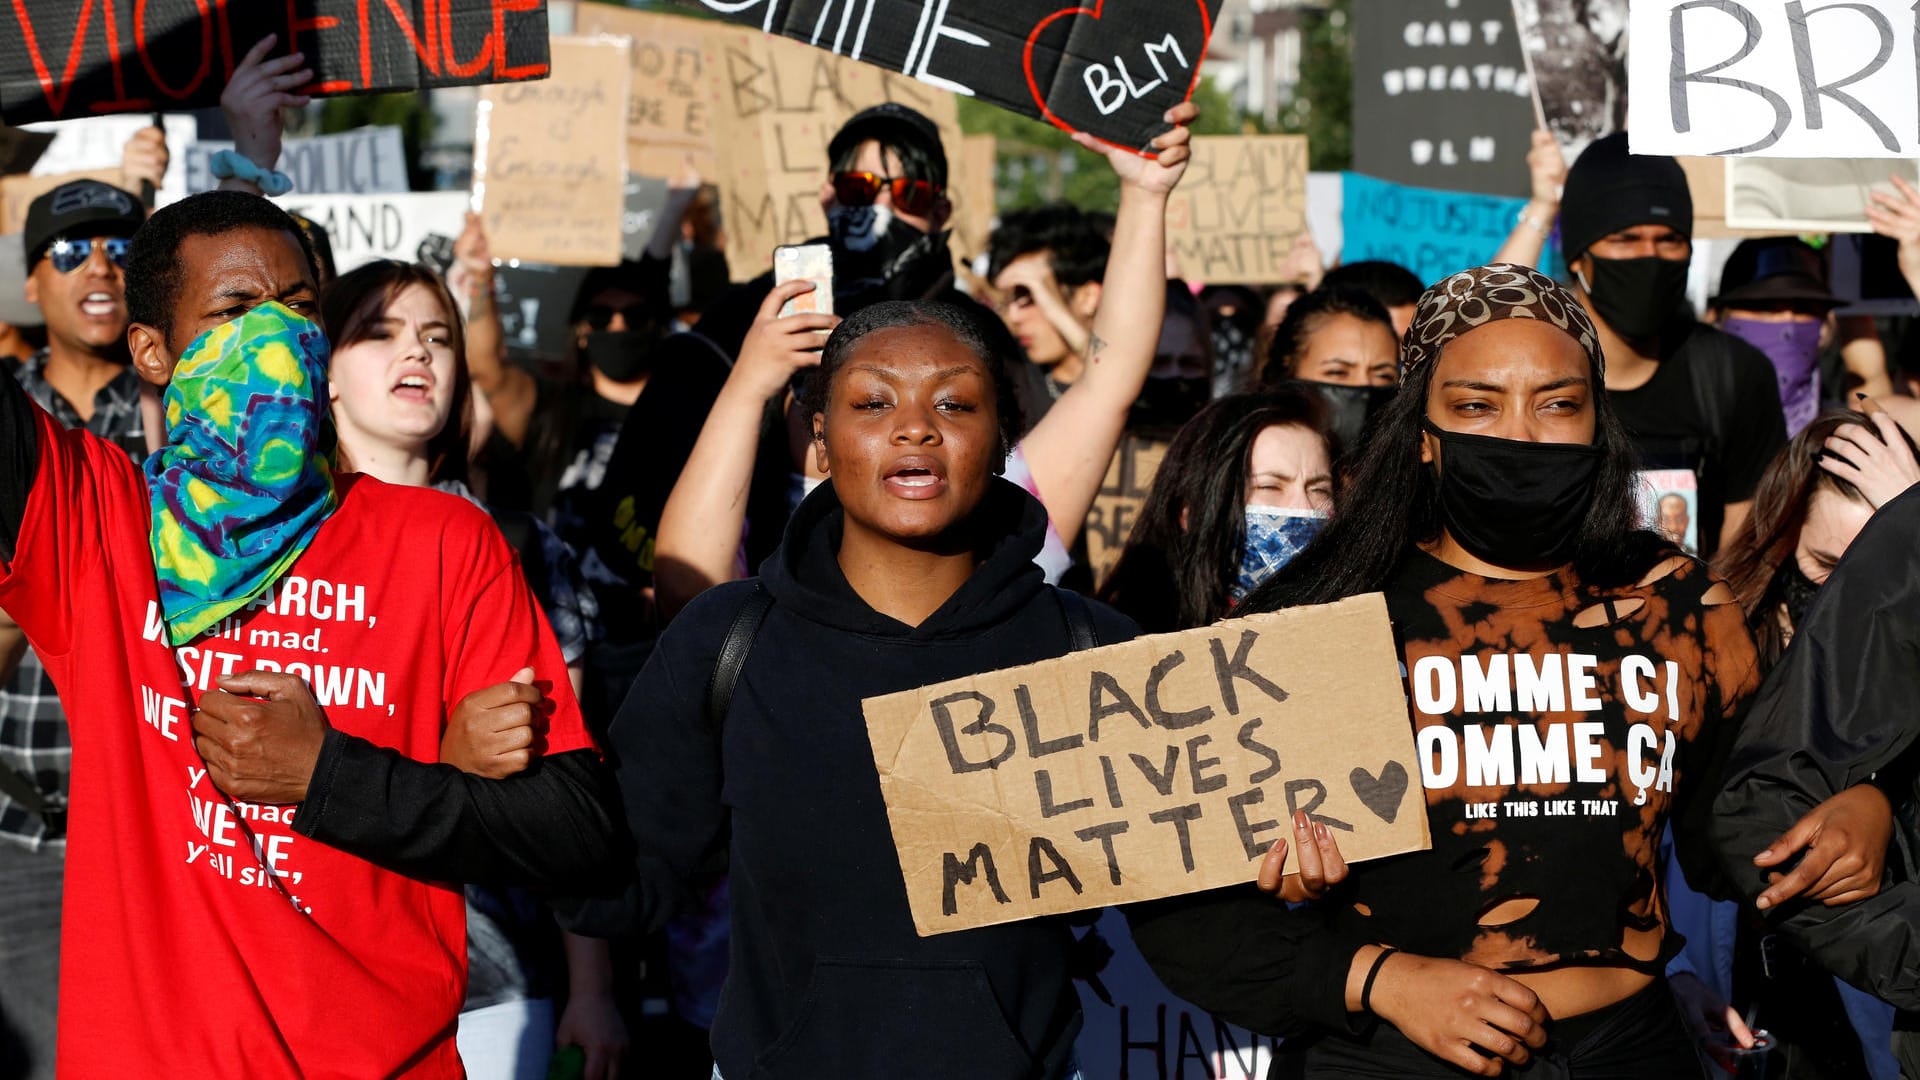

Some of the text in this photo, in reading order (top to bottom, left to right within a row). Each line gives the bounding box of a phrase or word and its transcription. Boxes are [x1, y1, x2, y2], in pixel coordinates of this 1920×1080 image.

[12, 0, 549, 117] VIOENCE
[1083, 33, 1189, 115] BLM
[289, 202, 403, 252] AND
[1402, 194, 1522, 240] JUSTIC
[1174, 230, 1297, 278] MATTE
[246, 576, 377, 629] ARCH,
[249, 627, 329, 654] mad.
[141, 684, 187, 743] WE
[930, 629, 1290, 774] BLACK
[1399, 653, 1680, 722] OMME CI
[1034, 717, 1281, 818] LIVES
[1416, 722, 1676, 806] OMME ÇA
[187, 788, 303, 886] WE IE,
[1465, 800, 1619, 819] LIKE THIS LIKE THAT
[185, 840, 233, 880] y'all
[942, 778, 1354, 916] MATTER
